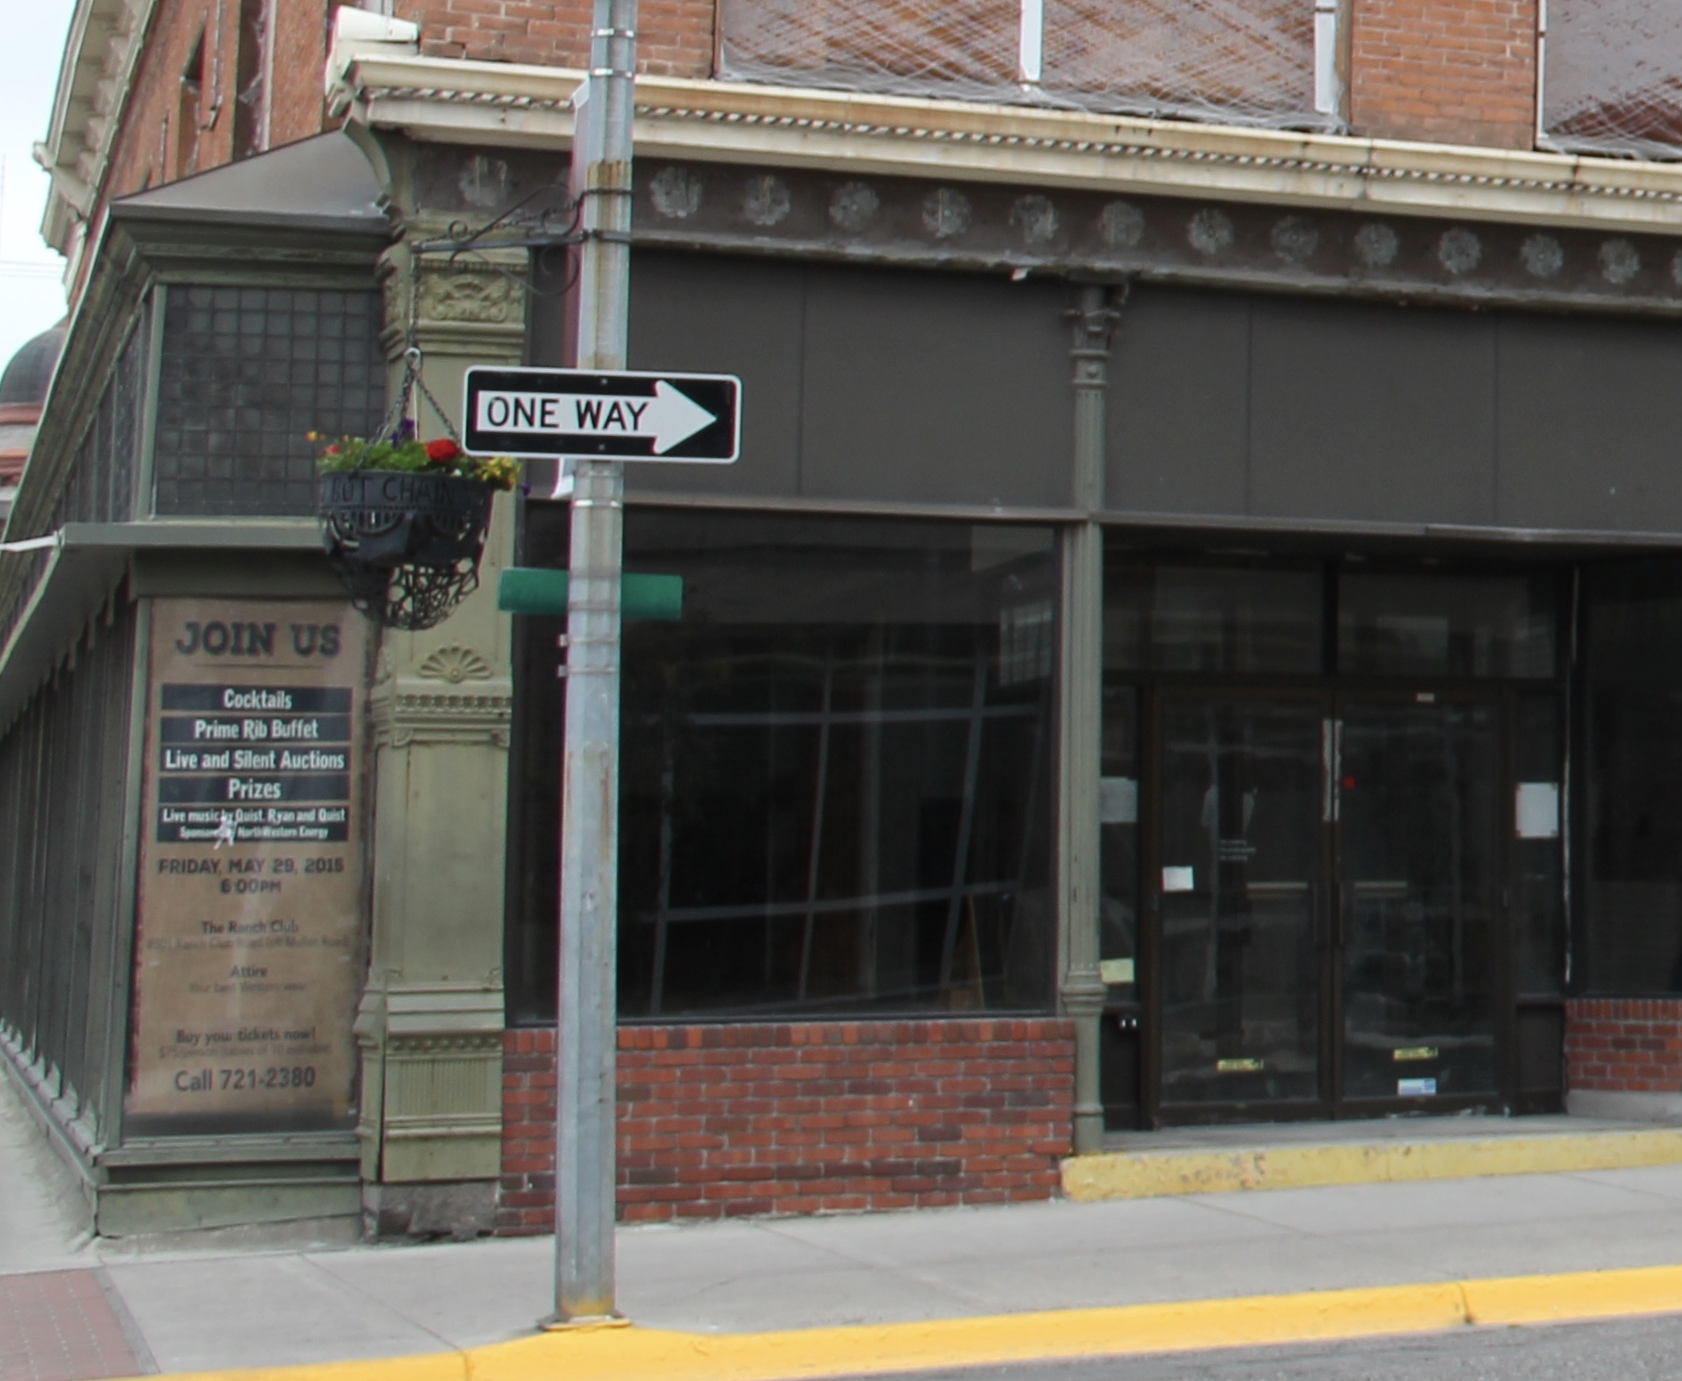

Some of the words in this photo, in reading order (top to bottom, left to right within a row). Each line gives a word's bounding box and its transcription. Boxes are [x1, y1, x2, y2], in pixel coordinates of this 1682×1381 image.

[487, 396, 559, 428] ONE
[576, 400, 649, 431] WAY
[174, 620, 277, 656] JOIN
[290, 623, 341, 657] US
[222, 688, 293, 710] Cocktails
[194, 719, 239, 740] Prime
[243, 719, 268, 740] Rib
[272, 718, 319, 739] Buffet
[165, 750, 198, 769] Live
[202, 750, 230, 769] and
[233, 749, 277, 769] Silent
[280, 749, 345, 769] Auctions
[227, 778, 282, 799] Prizes
[162, 808, 187, 822] Live
[188, 809, 219, 822] music
[268, 808, 295, 825] Ryan
[296, 809, 316, 822] and
[318, 808, 346, 822] Quist
[299, 826, 329, 839] Energy
[158, 857, 223, 876] FRIDAY,
[229, 857, 266, 874] MAY
[202, 920, 225, 935] The
[227, 919, 266, 934] Ranch
[269, 919, 300, 934] Club
[230, 964, 269, 978] Attire
[175, 1027, 201, 1046] Buy
[237, 1027, 281, 1042] tickets
[283, 1026, 317, 1040] now!
[173, 1068, 213, 1092] Call
[219, 1065, 317, 1090] 721-2380
